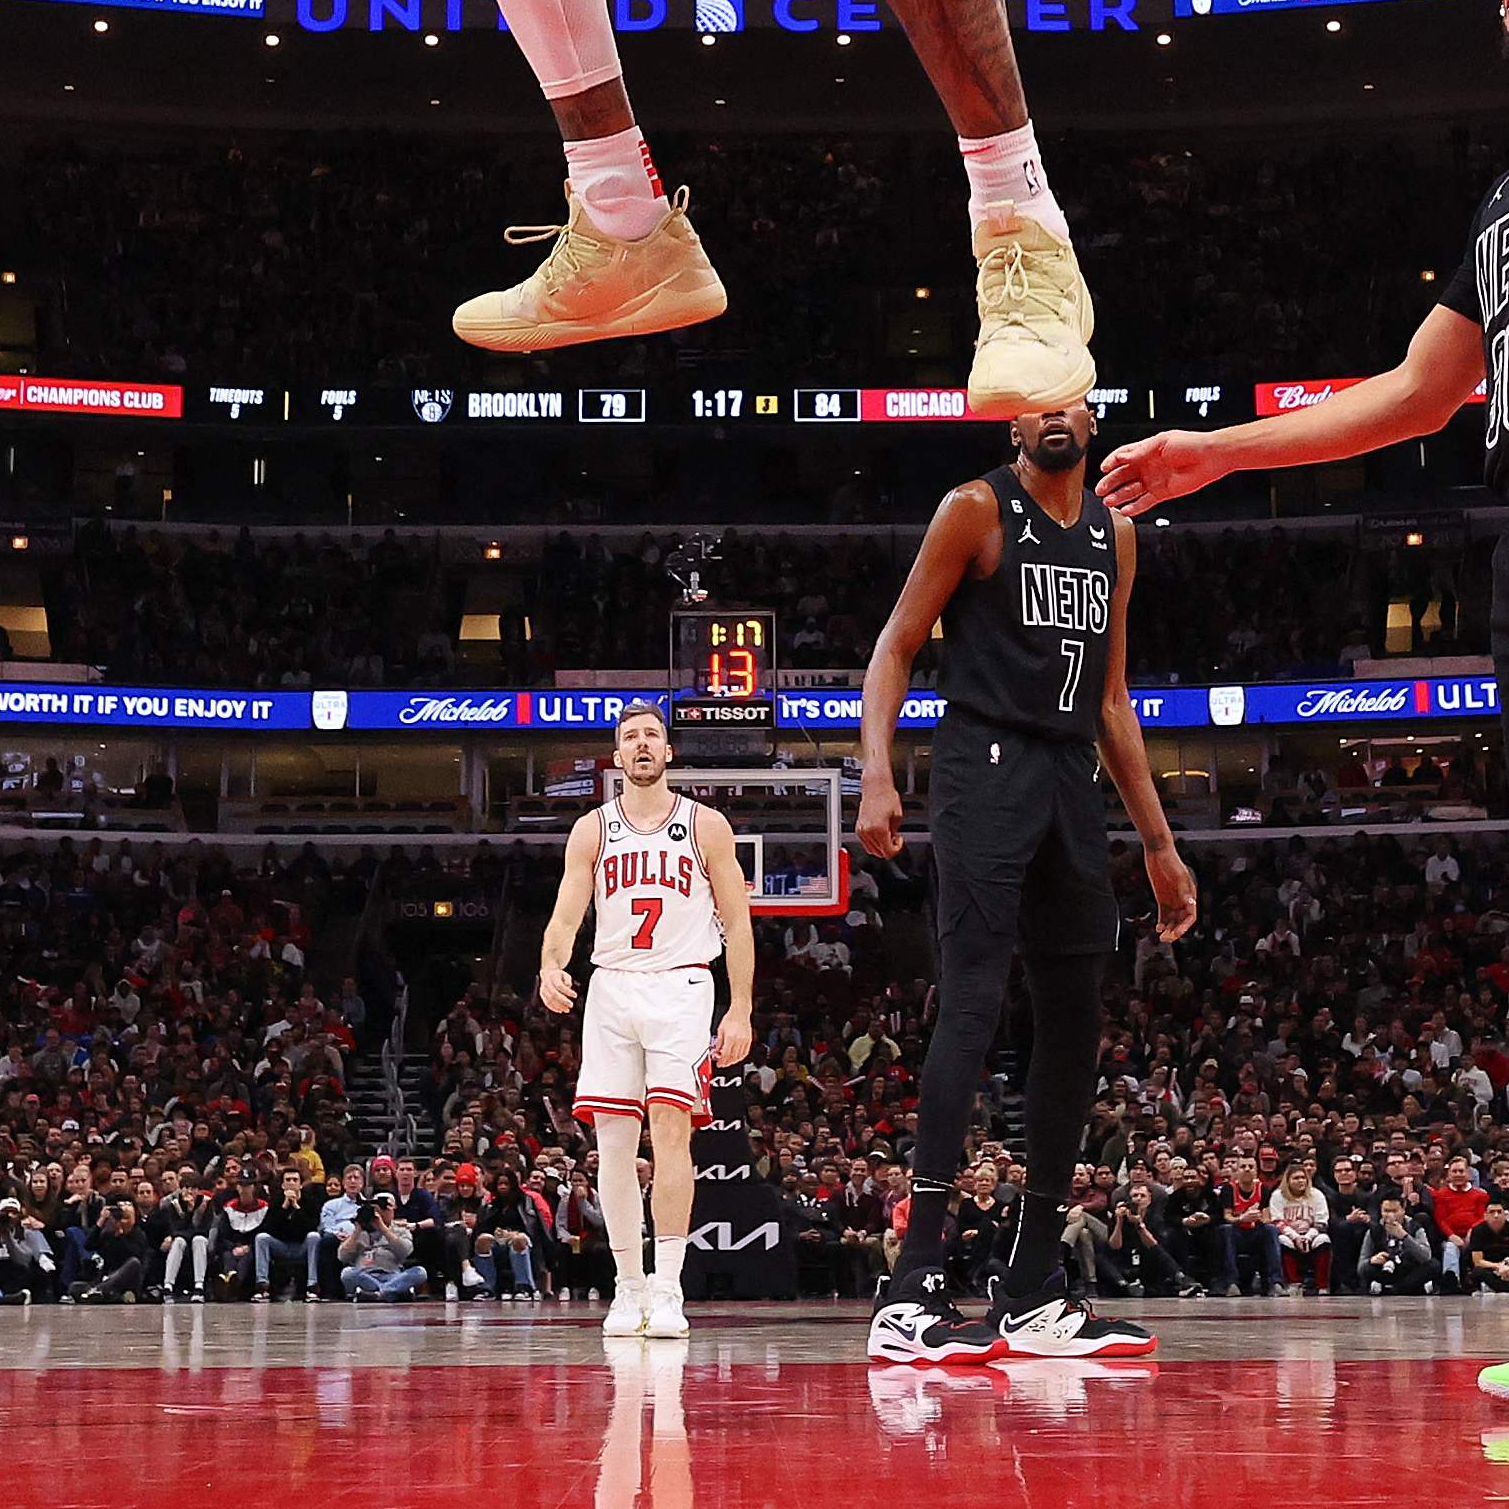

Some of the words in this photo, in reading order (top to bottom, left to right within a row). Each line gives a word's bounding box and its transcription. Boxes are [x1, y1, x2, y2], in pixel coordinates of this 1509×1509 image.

[26, 387, 120, 408] CHAMPIONS
[123, 392, 164, 410] CLUB
[209, 387, 264, 405] TIMEOUTS
[320, 389, 358, 406] FOULS
[468, 392, 562, 418] BROOKLYN
[599, 393, 626, 418] 79
[691, 389, 743, 417] 1:17
[814, 392, 841, 417] 84
[885, 391, 965, 418] CHICAGO
[1185, 385, 1221, 403] FOULS
[230, 403, 241, 419] 5
[332, 405, 343, 421] 5
[1096, 402, 1106, 419] 3
[1198, 401, 1208, 418] 4
[1011, 498, 1024, 514] 6
[1021, 562, 1109, 634] NETS
[711, 620, 762, 647] 1:17
[709, 650, 756, 697] 13
[1058, 638, 1085, 712] 7
[73, 694, 94, 714] IT
[97, 695, 119, 715] IF
[122, 696, 169, 717] YOU
[174, 698, 247, 719] ENJOY
[252, 700, 273, 720] IT
[398, 697, 512, 724] Michelob
[702, 707, 770, 720] TISSOT
[1296, 687, 1409, 717] Michelob
[603, 850, 694, 900] BULLS
[631, 897, 663, 950] 7
